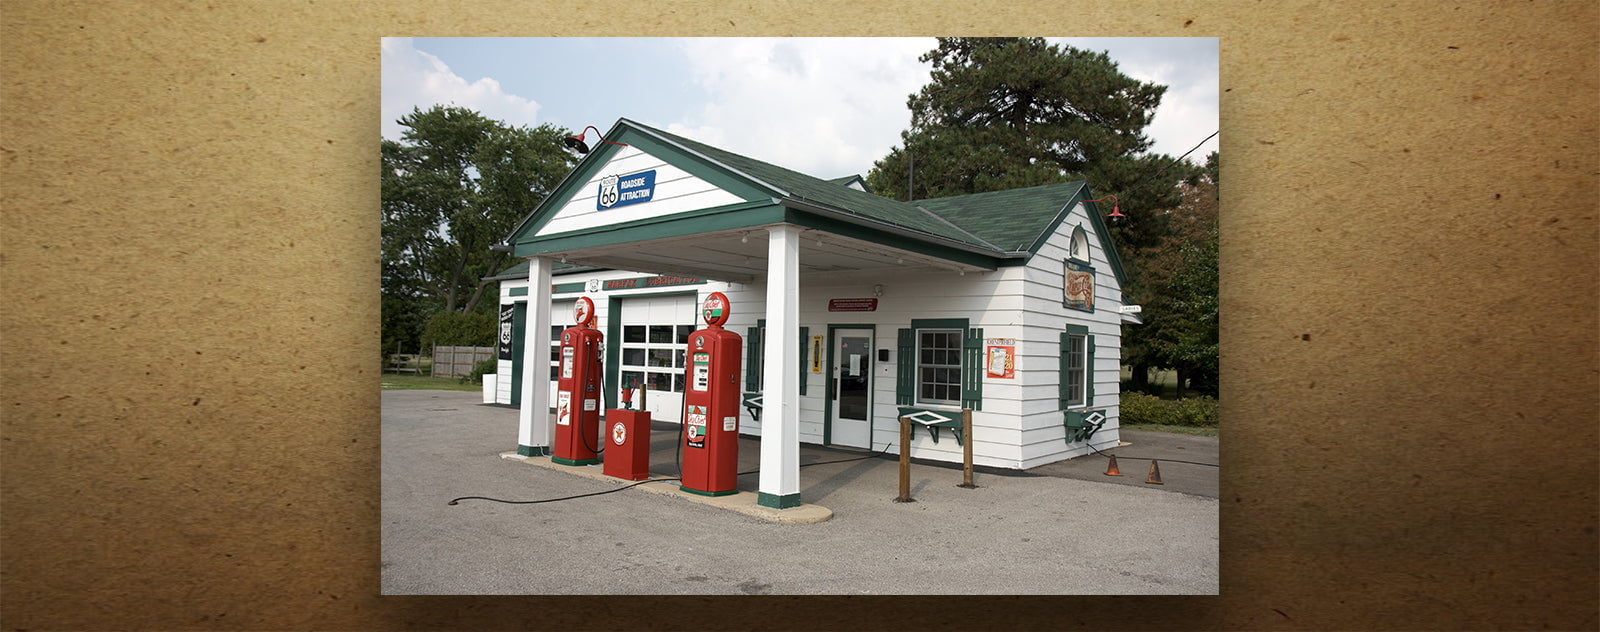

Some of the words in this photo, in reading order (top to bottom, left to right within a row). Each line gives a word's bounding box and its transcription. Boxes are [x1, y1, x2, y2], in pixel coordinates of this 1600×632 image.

[602, 177, 616, 185] ROUTE
[621, 177, 646, 189] ROADSIDE
[602, 186, 616, 204] 66
[620, 189, 650, 201] ATTRACTION
[502, 331, 510, 341] 66
[1005, 362, 1013, 370] 20
